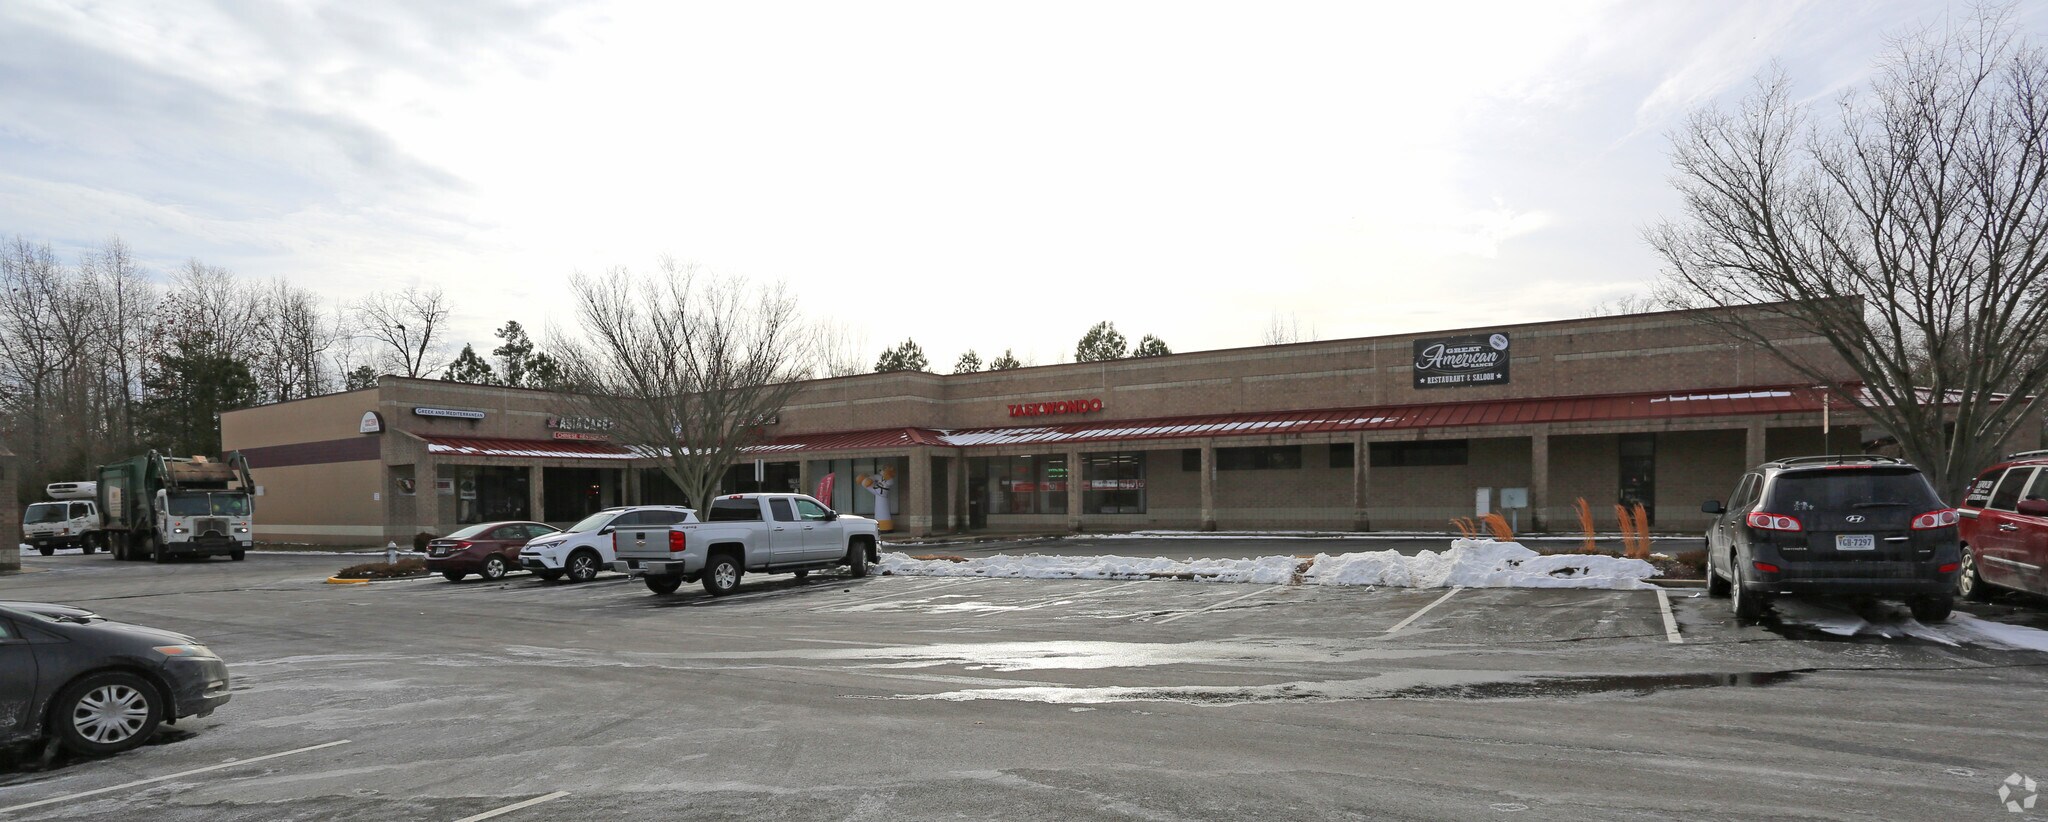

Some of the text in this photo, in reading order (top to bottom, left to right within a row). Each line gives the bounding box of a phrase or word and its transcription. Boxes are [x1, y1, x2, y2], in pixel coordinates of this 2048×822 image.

[1416, 344, 1498, 369] American
[1446, 346, 1481, 354] GREAT
[1427, 375, 1464, 384] RESTAURANT
[1473, 373, 1494, 381] SALOON
[1008, 398, 1102, 417] TAEKWONDO
[559, 417, 582, 430] ASIA
